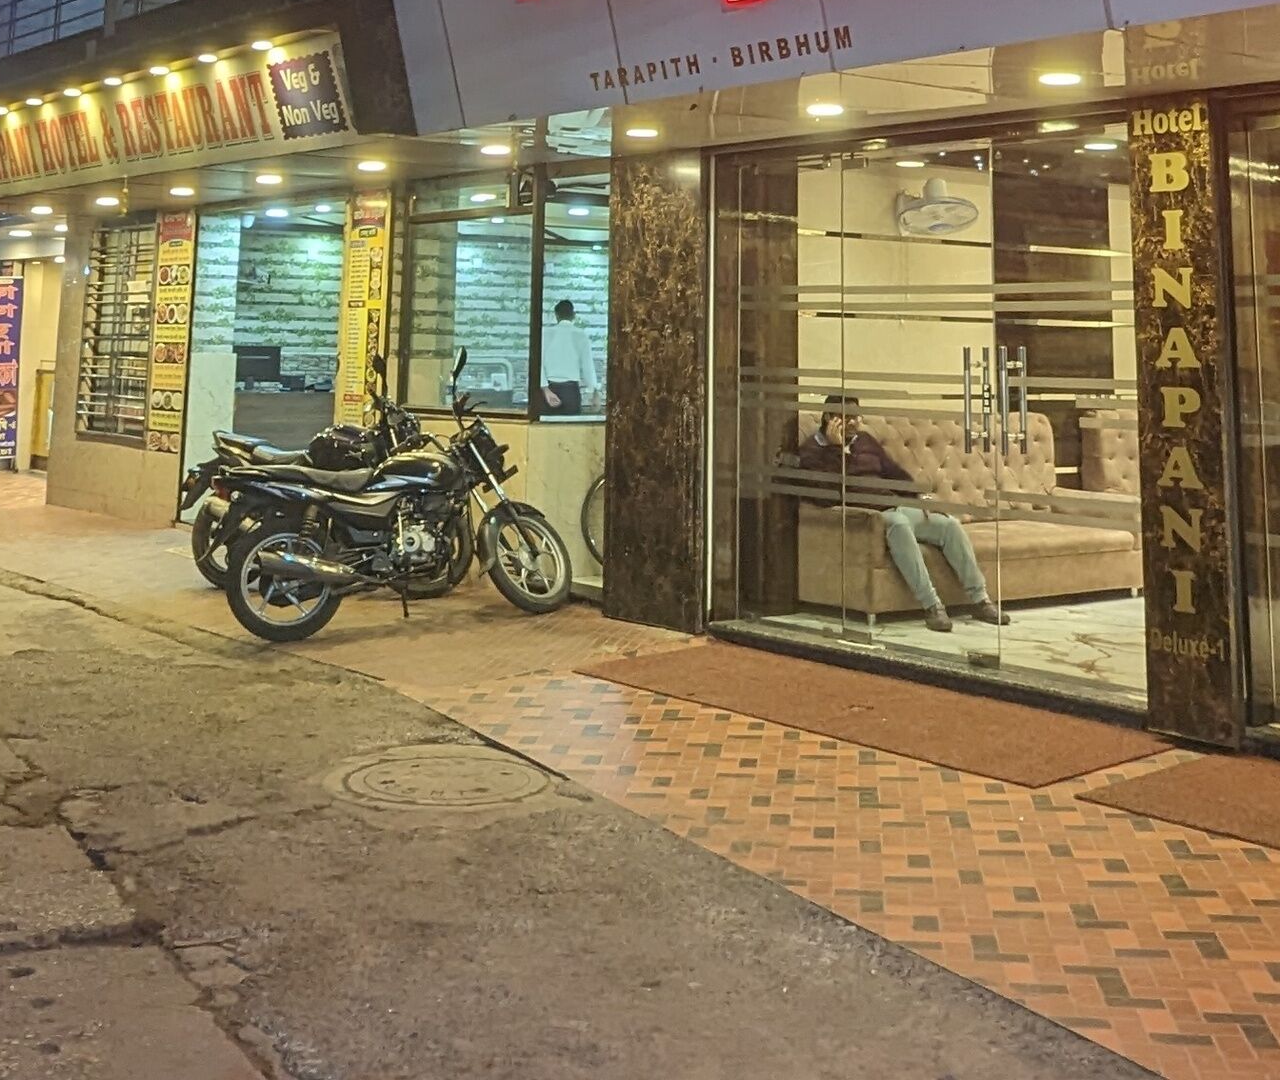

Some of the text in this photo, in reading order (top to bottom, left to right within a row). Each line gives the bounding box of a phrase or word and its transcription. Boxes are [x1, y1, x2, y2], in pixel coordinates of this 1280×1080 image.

[280, 64, 321, 94] Veg &
[590, 25, 853, 92] TARAPITH BIRBHUM
[35, 110, 102, 178] HOTEL
[100, 106, 121, 166] &
[116, 70, 275, 163] RESTAURANT
[282, 101, 339, 127] Non Veg
[1132, 103, 1202, 136] Hotel
[1148, 151, 1204, 614] BINAPANI
